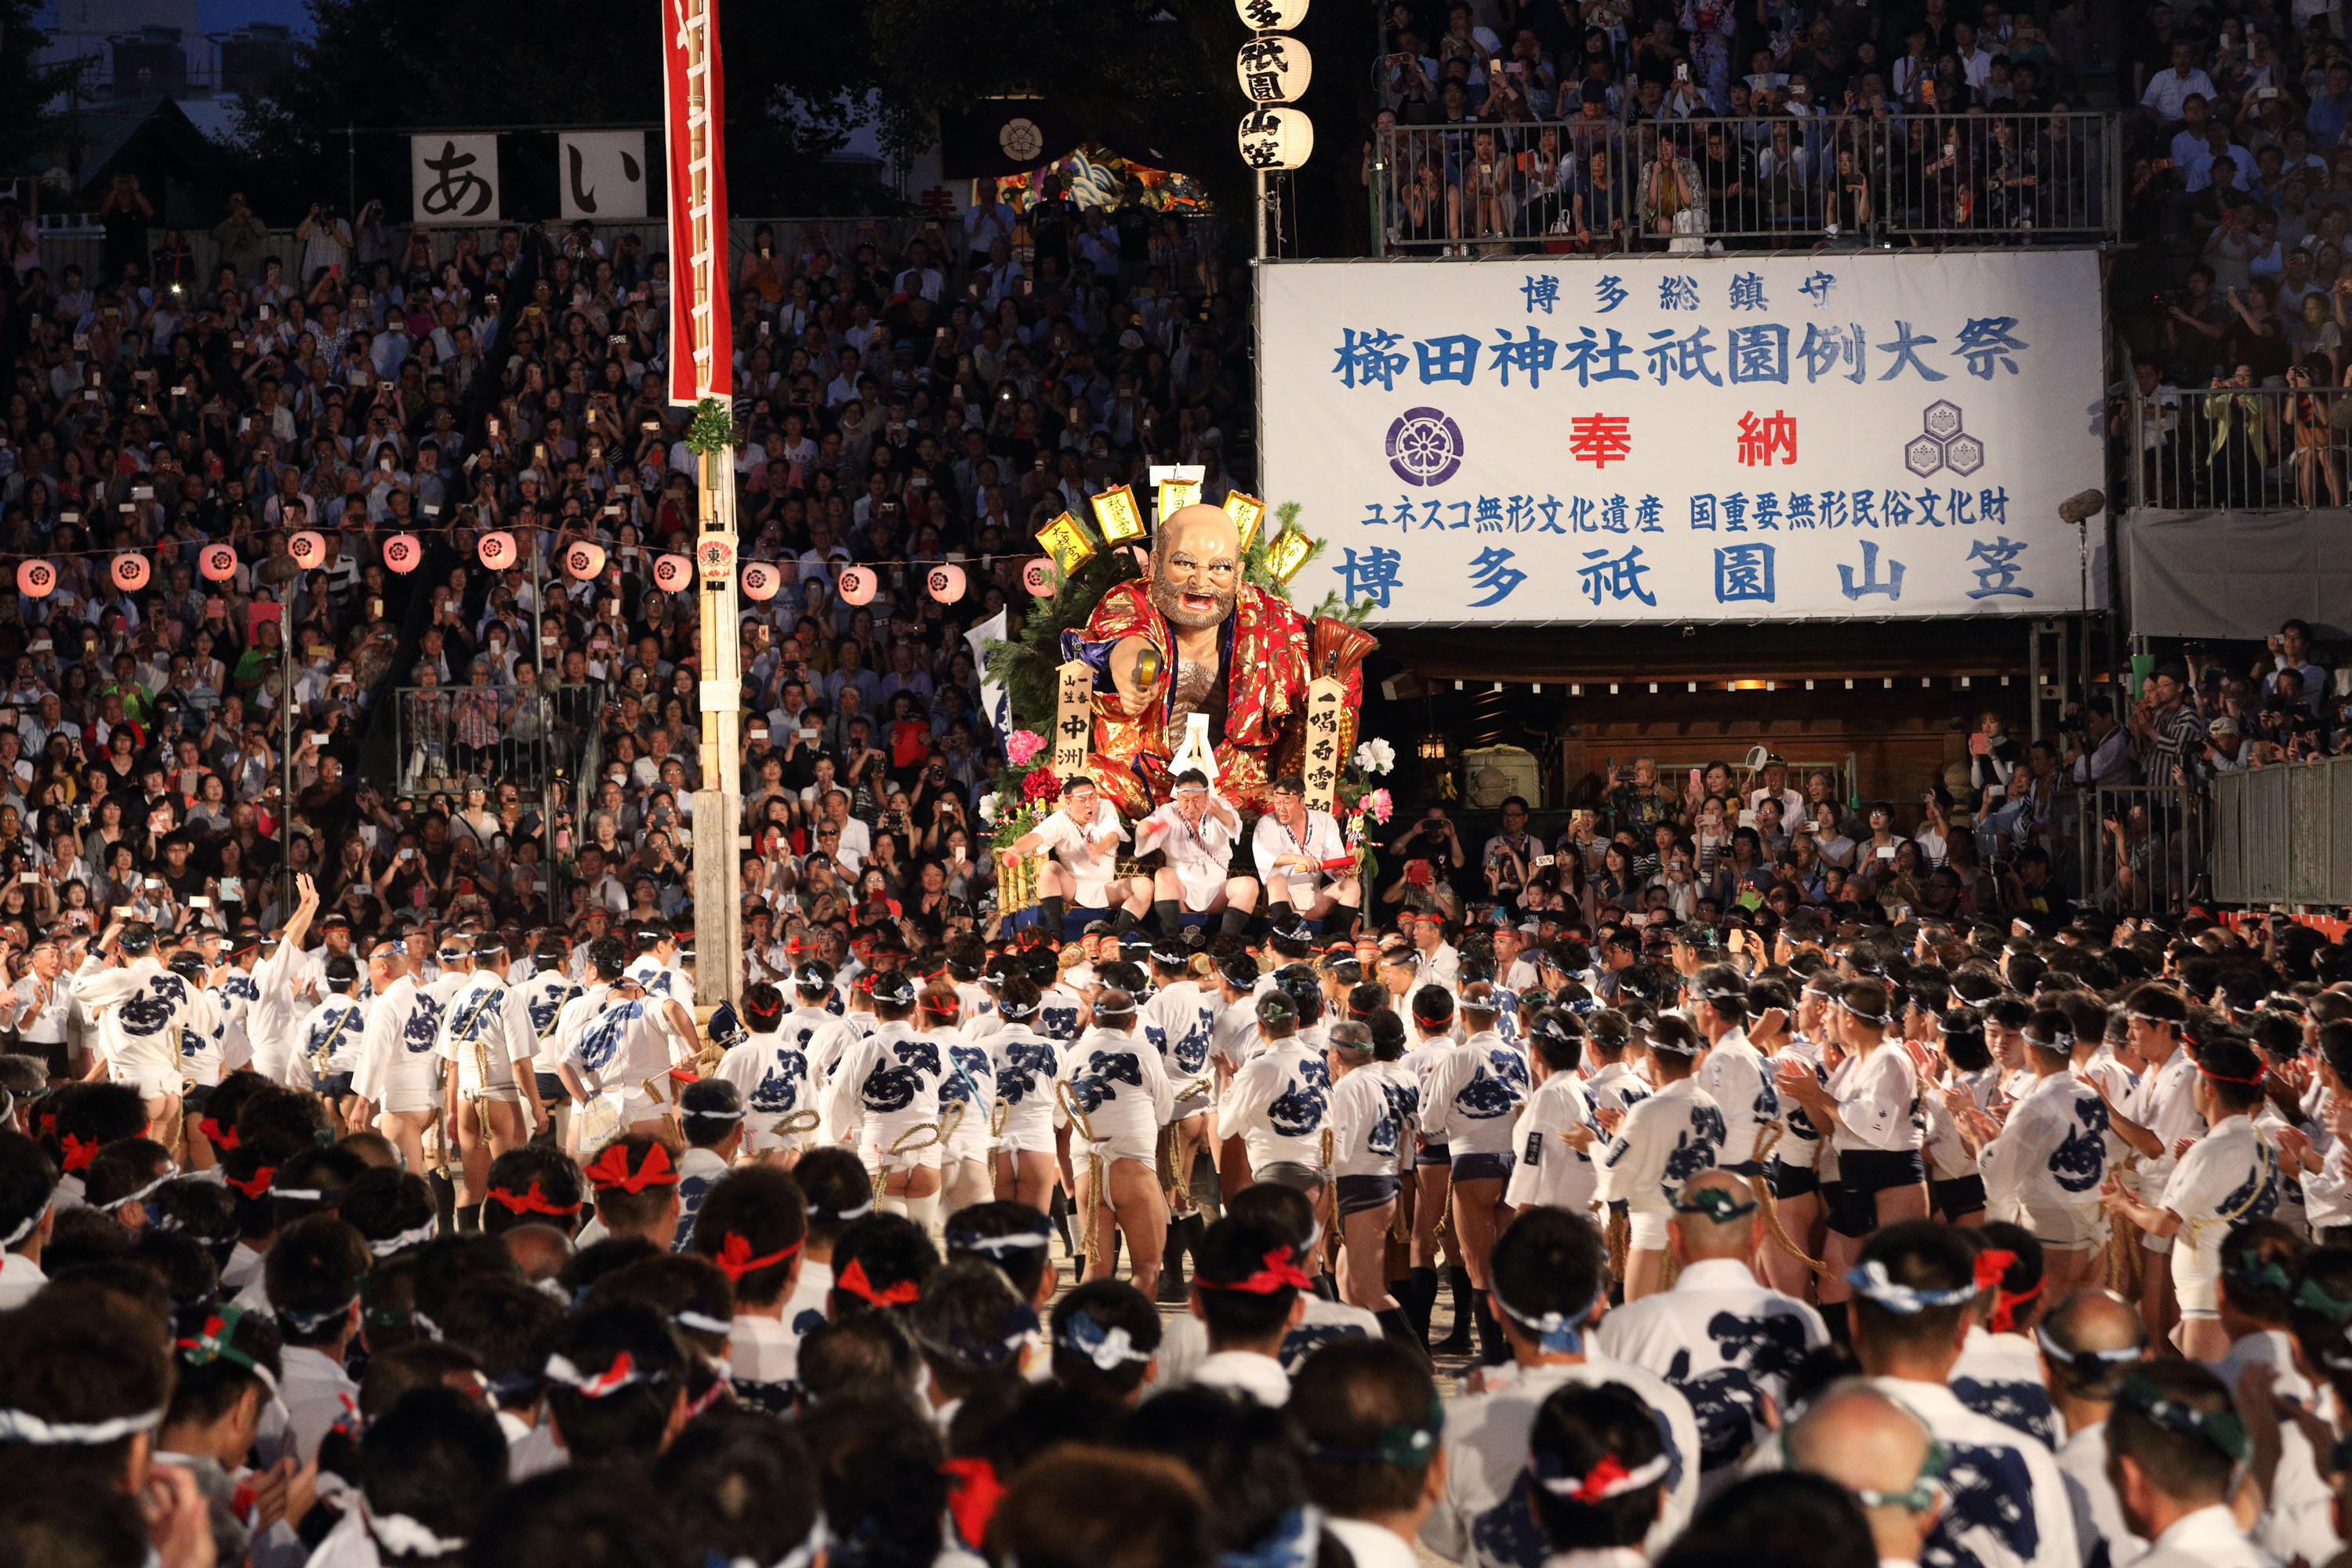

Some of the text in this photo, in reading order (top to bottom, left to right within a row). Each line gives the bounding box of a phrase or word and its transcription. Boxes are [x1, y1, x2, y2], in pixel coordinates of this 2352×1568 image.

[1241, 110, 1284, 169] 山笠
[422, 141, 492, 216] あ
[567, 143, 641, 213] い
[1519, 270, 1840, 314] 博多総鎮守
[1332, 315, 2031, 391] 櫛田神社祇園例大祭
[1569, 409, 1799, 469] 奉納
[1360, 486, 2010, 534] ユネスコ無形文化遺産 国重要無形民俗文化財
[708, 547, 720, 564] 東
[1332, 535, 2034, 608] 博多祇園山笠
[1064, 675, 1076, 703] 山笠
[1077, 677, 1089, 704] 一番
[1058, 715, 1087, 781] 中洲
